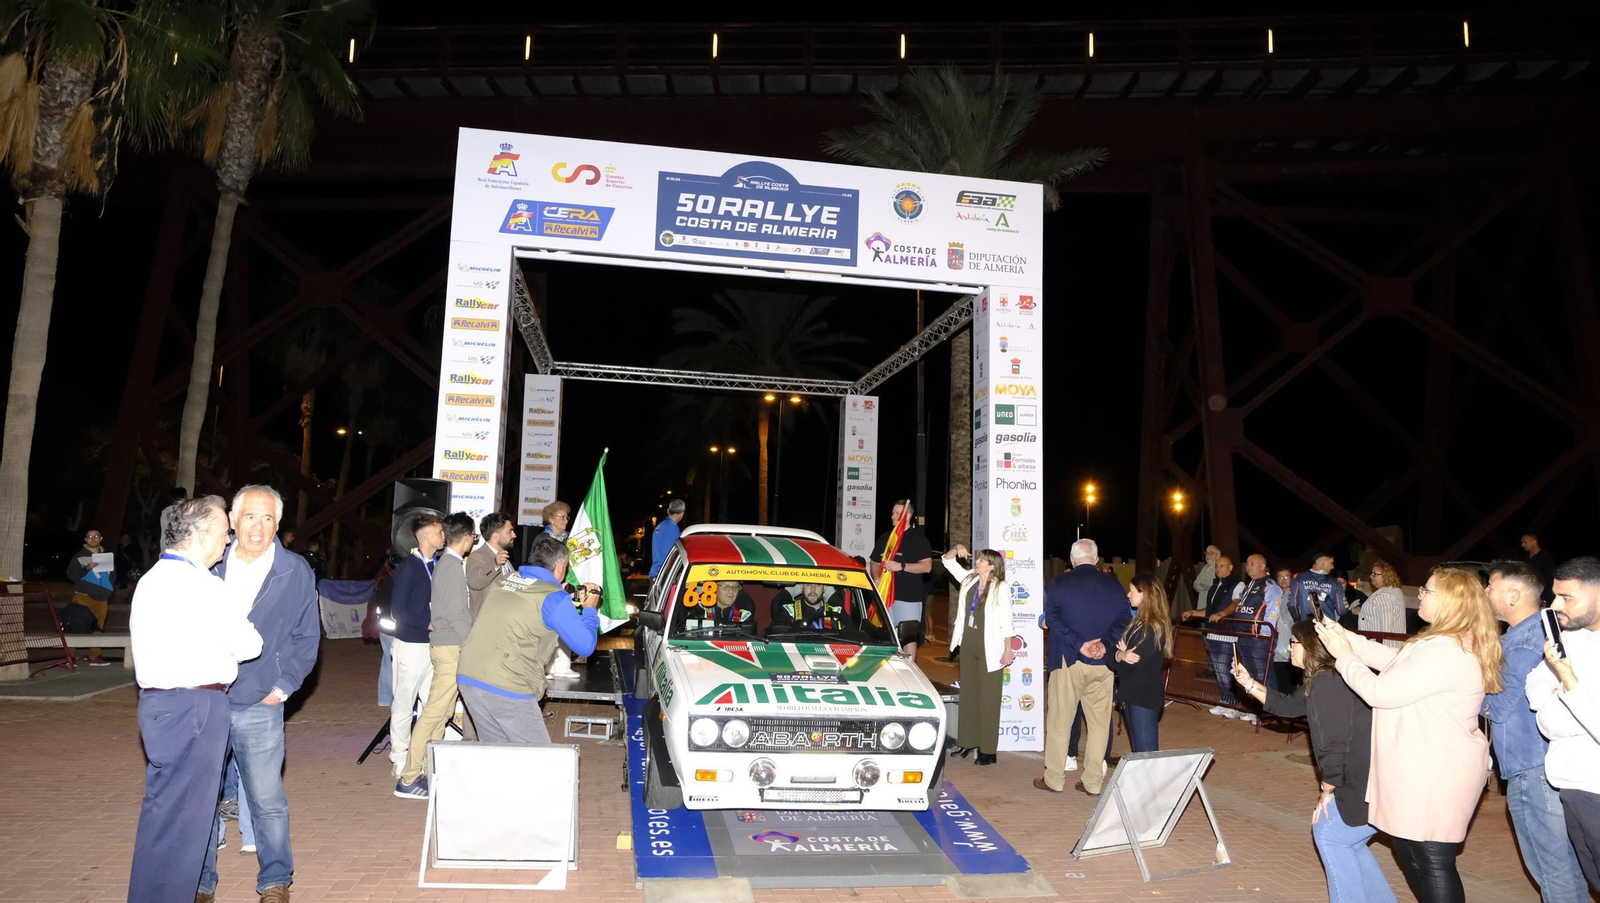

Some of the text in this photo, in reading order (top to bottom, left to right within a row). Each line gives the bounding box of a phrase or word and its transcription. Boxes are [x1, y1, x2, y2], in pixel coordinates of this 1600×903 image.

[543, 206, 600, 221] CERA
[718, 196, 841, 226] RALLYE
[554, 224, 588, 236] Recalvi
[676, 216, 838, 240] COSTA DE ALMERÍA
[894, 244, 936, 256] COSTA DE
[884, 254, 937, 268] ALMERÍA
[969, 252, 1027, 265] DIPUTACIÓN
[969, 262, 1024, 274] DE ALMERÍA
[456, 298, 499, 310] Rallycar
[461, 320, 490, 329] Recalvi
[450, 374, 494, 385] Rallycar
[995, 384, 1037, 396] MOYA
[455, 396, 485, 404] Recalvi
[995, 433, 1036, 444] gasolia
[444, 450, 488, 461] Rallycar
[448, 472, 479, 481] Recalvi
[996, 478, 1036, 490] Phonika
[846, 511, 872, 520] Phonika
[682, 580, 718, 607] 68
[695, 683, 936, 709] Alitalia
[794, 842, 898, 852] ALMERÍA
